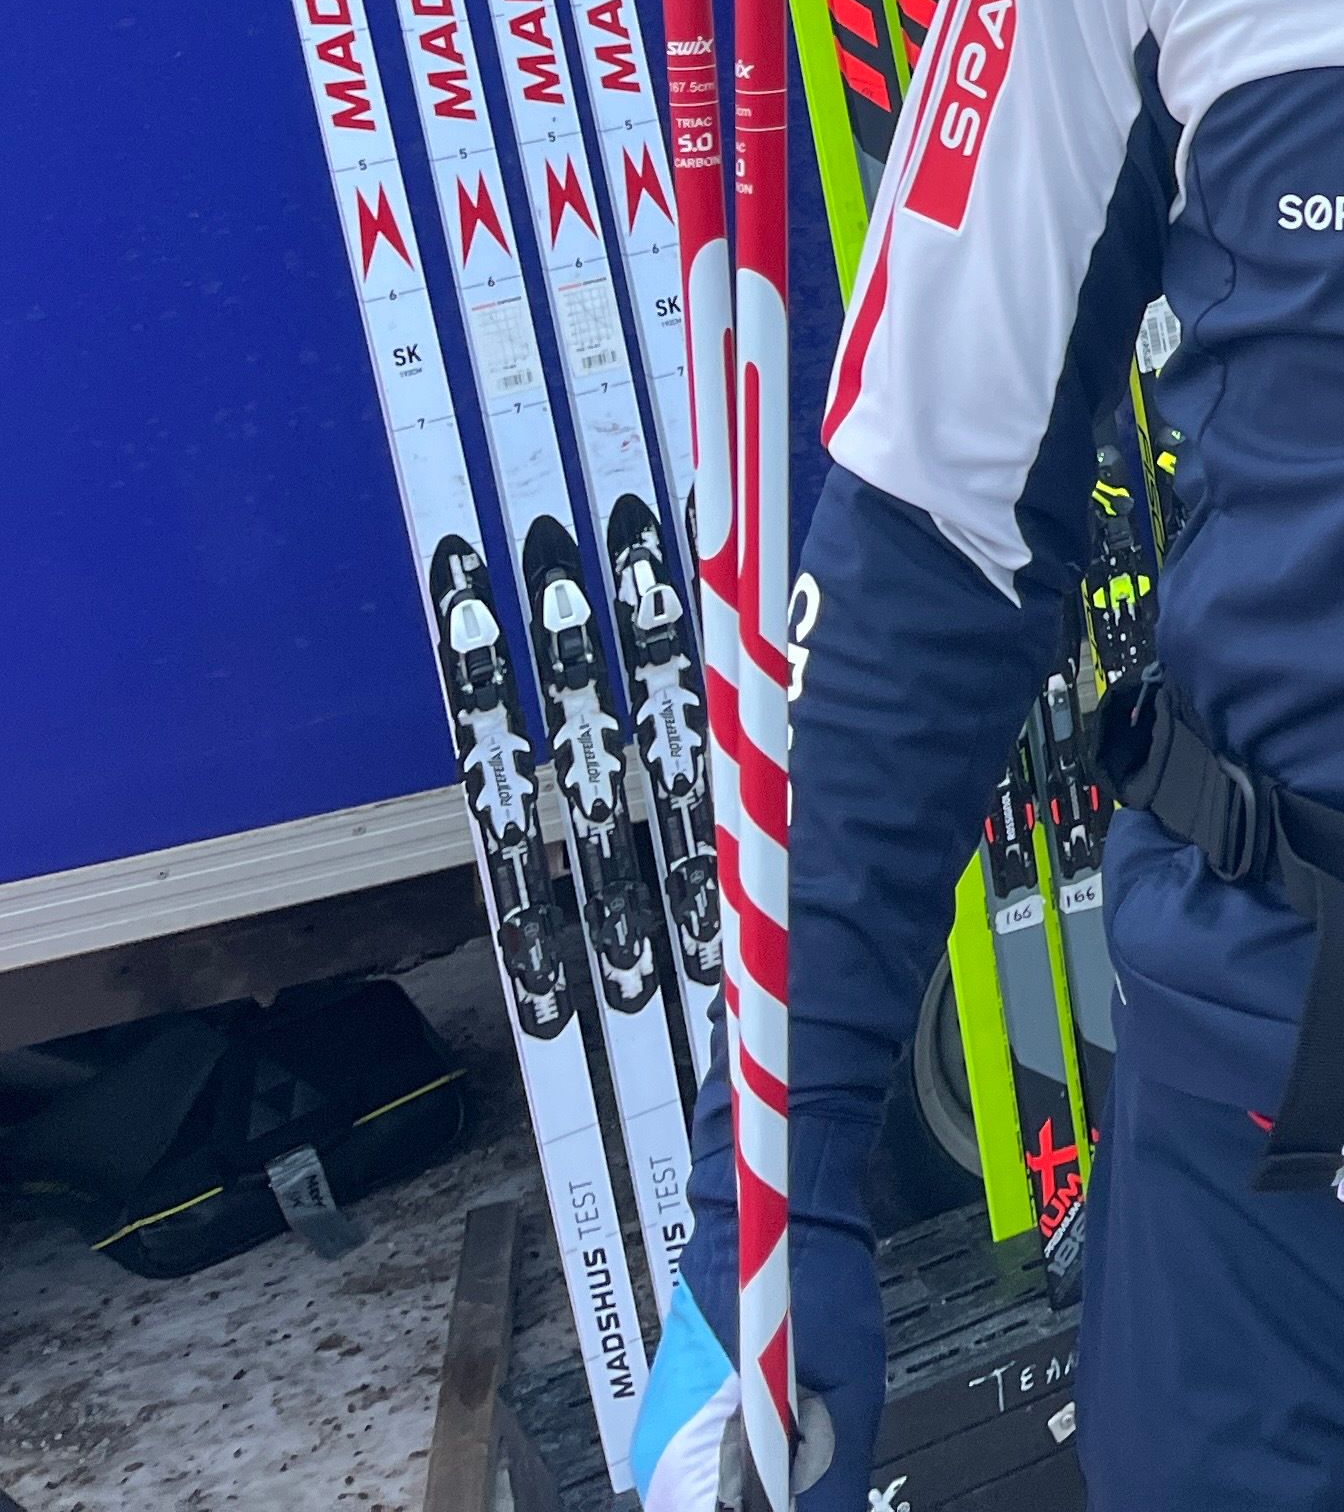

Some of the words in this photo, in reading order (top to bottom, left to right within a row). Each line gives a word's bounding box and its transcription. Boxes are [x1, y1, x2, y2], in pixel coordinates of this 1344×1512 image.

[676, 116, 712, 129] TRIAC
[678, 133, 713, 153] 5.0
[655, 296, 682, 317] SK
[393, 343, 422, 367] SK
[650, 1154, 682, 1215] TEST
[570, 1179, 601, 1240] TEST
[584, 1245, 636, 1399] MADSHUS
